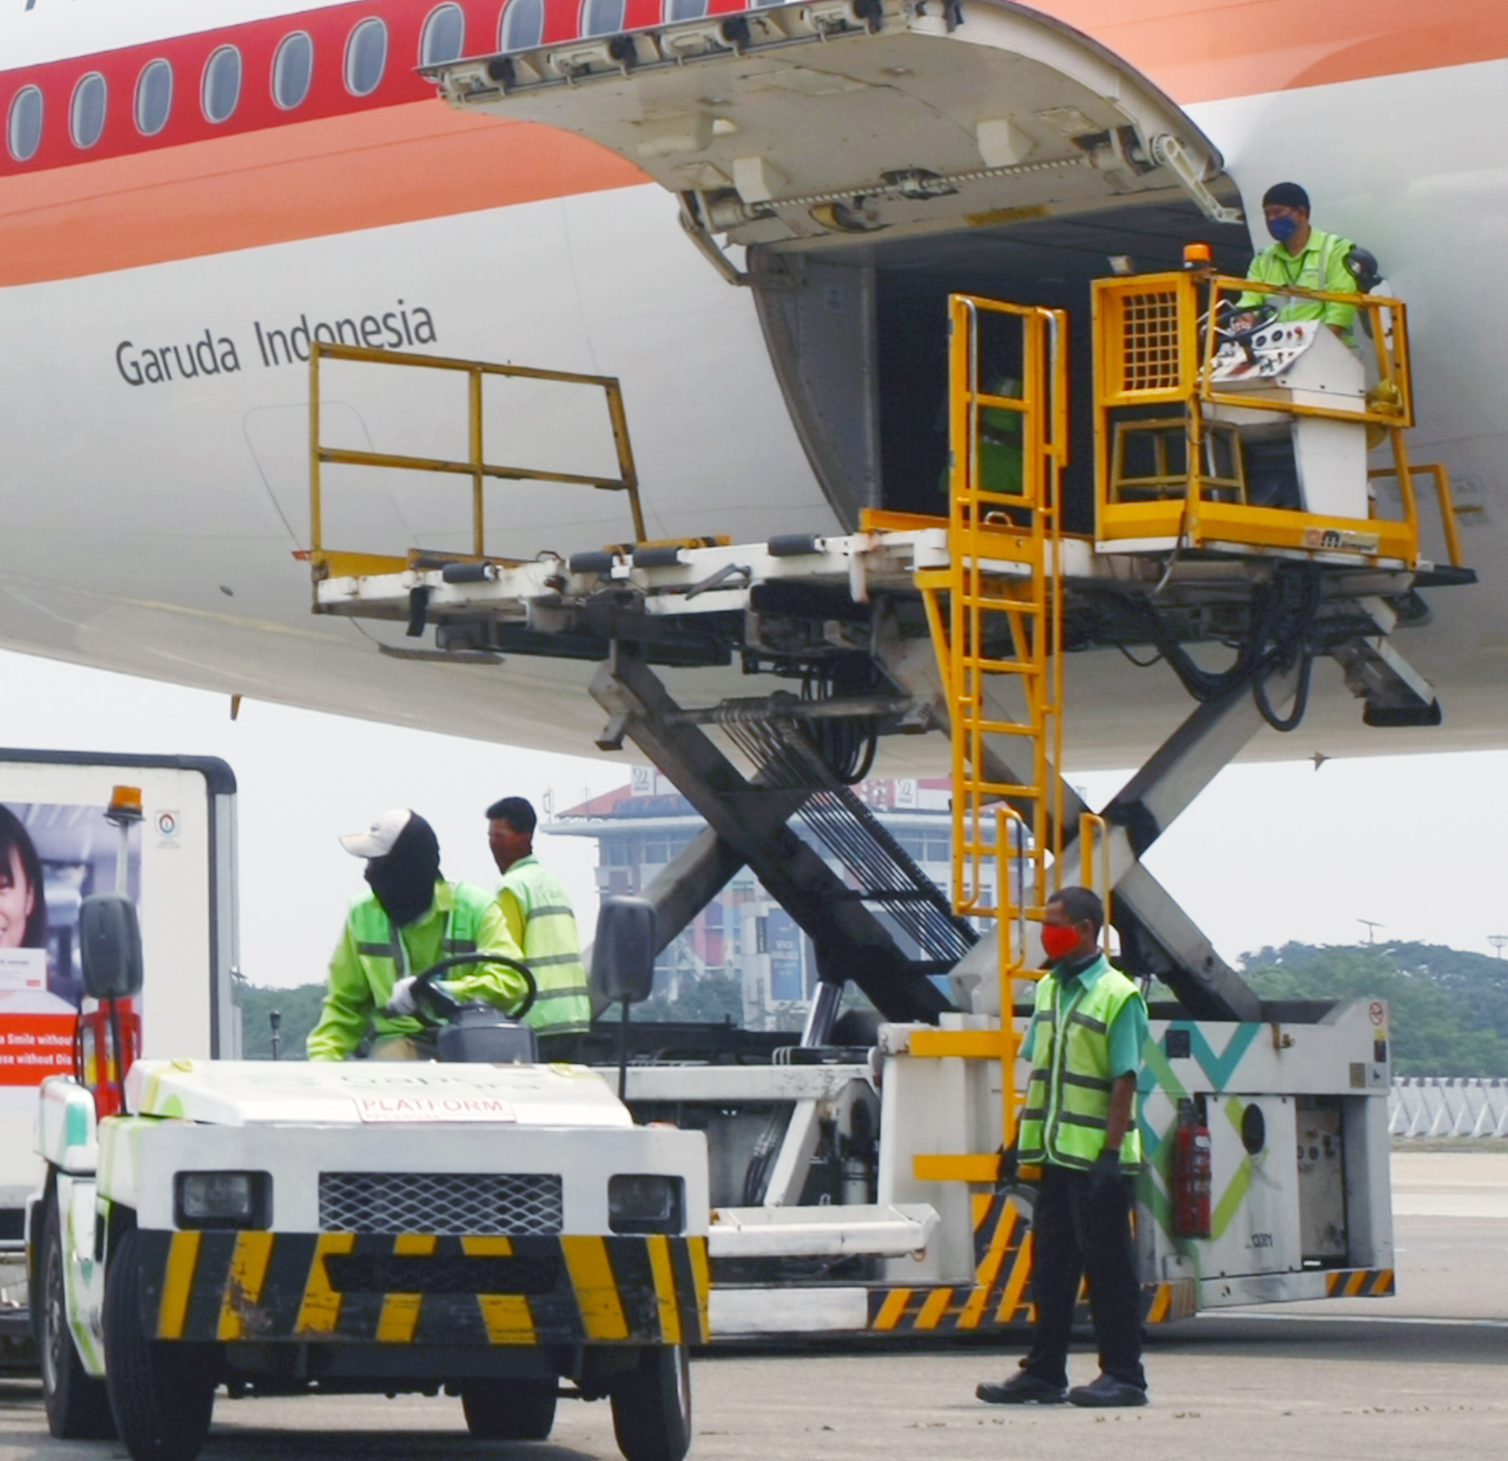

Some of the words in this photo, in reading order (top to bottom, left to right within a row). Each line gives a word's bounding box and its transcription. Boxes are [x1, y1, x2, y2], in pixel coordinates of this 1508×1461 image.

[114, 328, 241, 387] Garuda
[253, 298, 438, 367] Indonesia
[7, 1033, 35, 1046] Smile
[16, 1053, 54, 1066] without
[362, 1099, 505, 1113] PLATFORM
